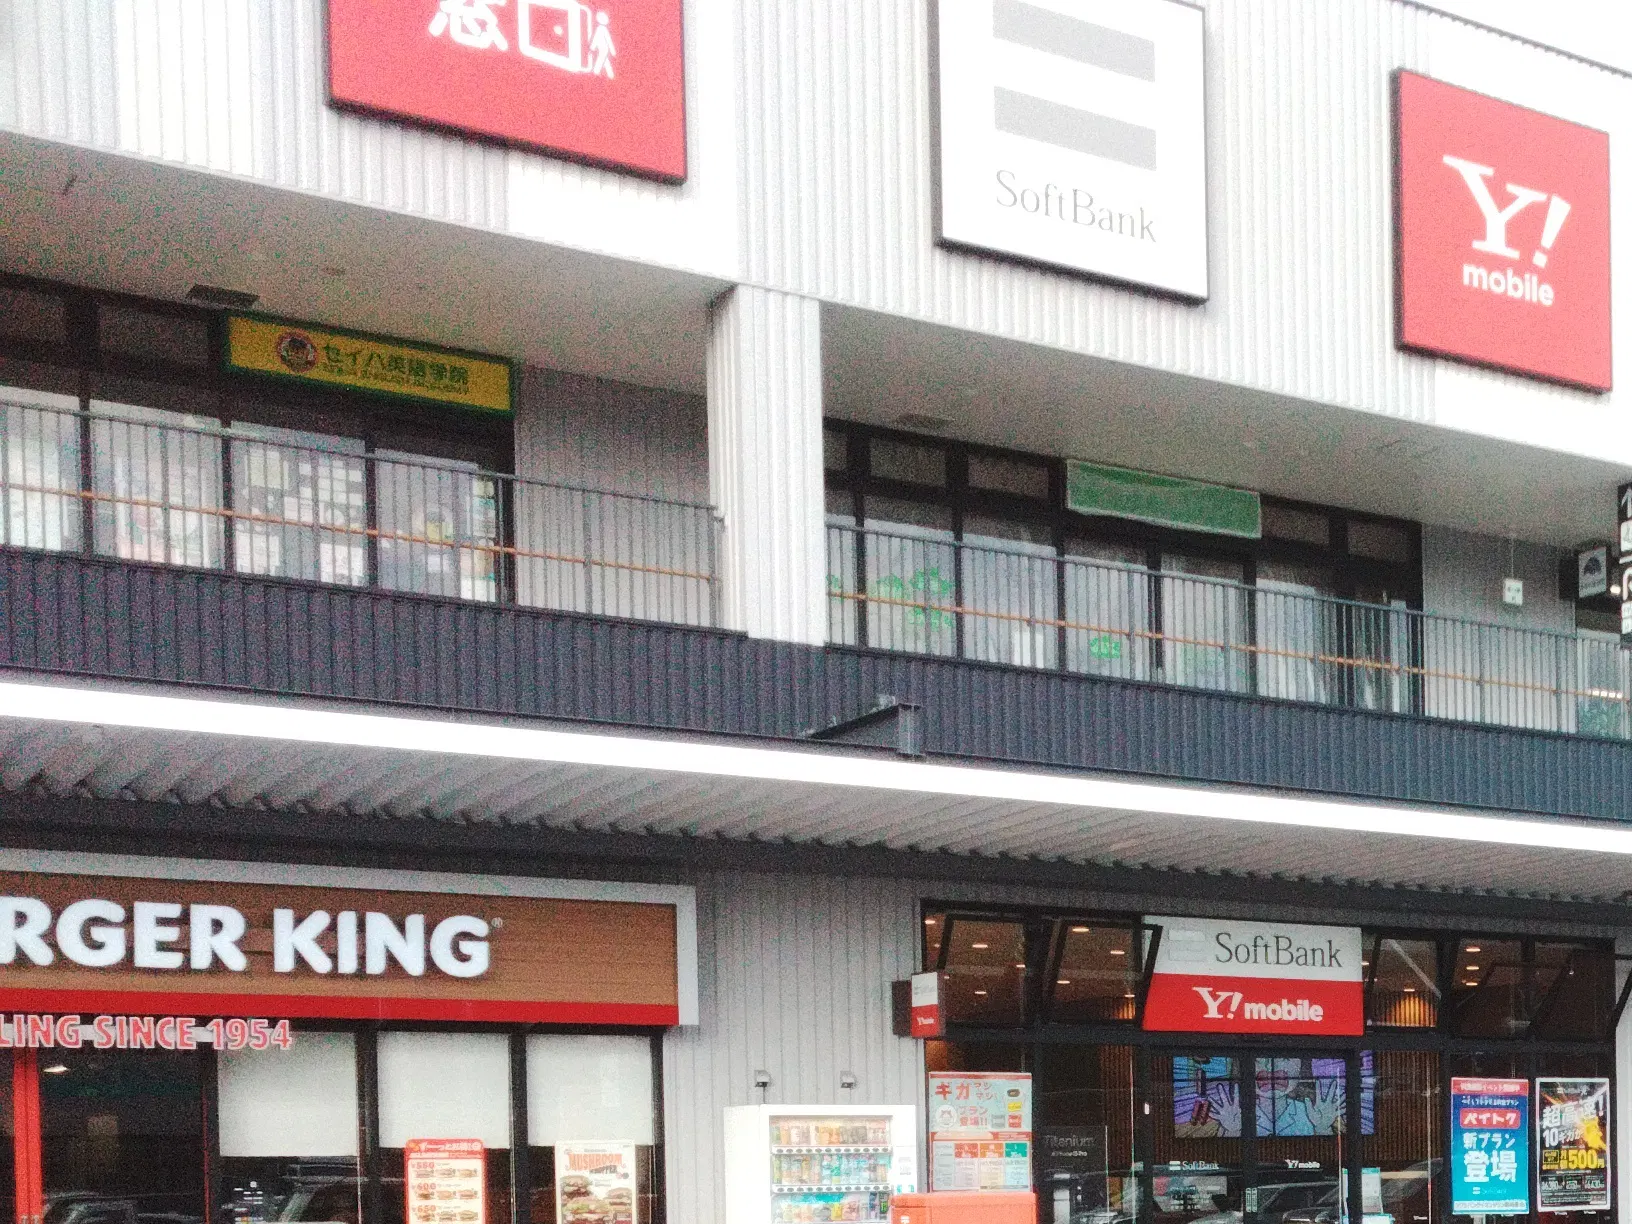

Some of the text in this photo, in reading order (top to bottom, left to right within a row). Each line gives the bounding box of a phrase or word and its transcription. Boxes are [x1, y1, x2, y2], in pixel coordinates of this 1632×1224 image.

[996, 169, 1157, 242] SoftBank
[1442, 155, 1571, 269] Y!
[1462, 263, 1555, 307] mobile
[273, 908, 490, 978] KING
[1215, 932, 1343, 967] SoftBank
[94, 1015, 196, 1049] SINCE
[207, 1018, 292, 1050] 1954
[1044, 1134, 1095, 1147] Titanium
[1463, 1132, 1517, 1149] 新プラン
[1182, 1160, 1220, 1170] SoftBank
[1463, 1150, 1518, 1183] 登場
